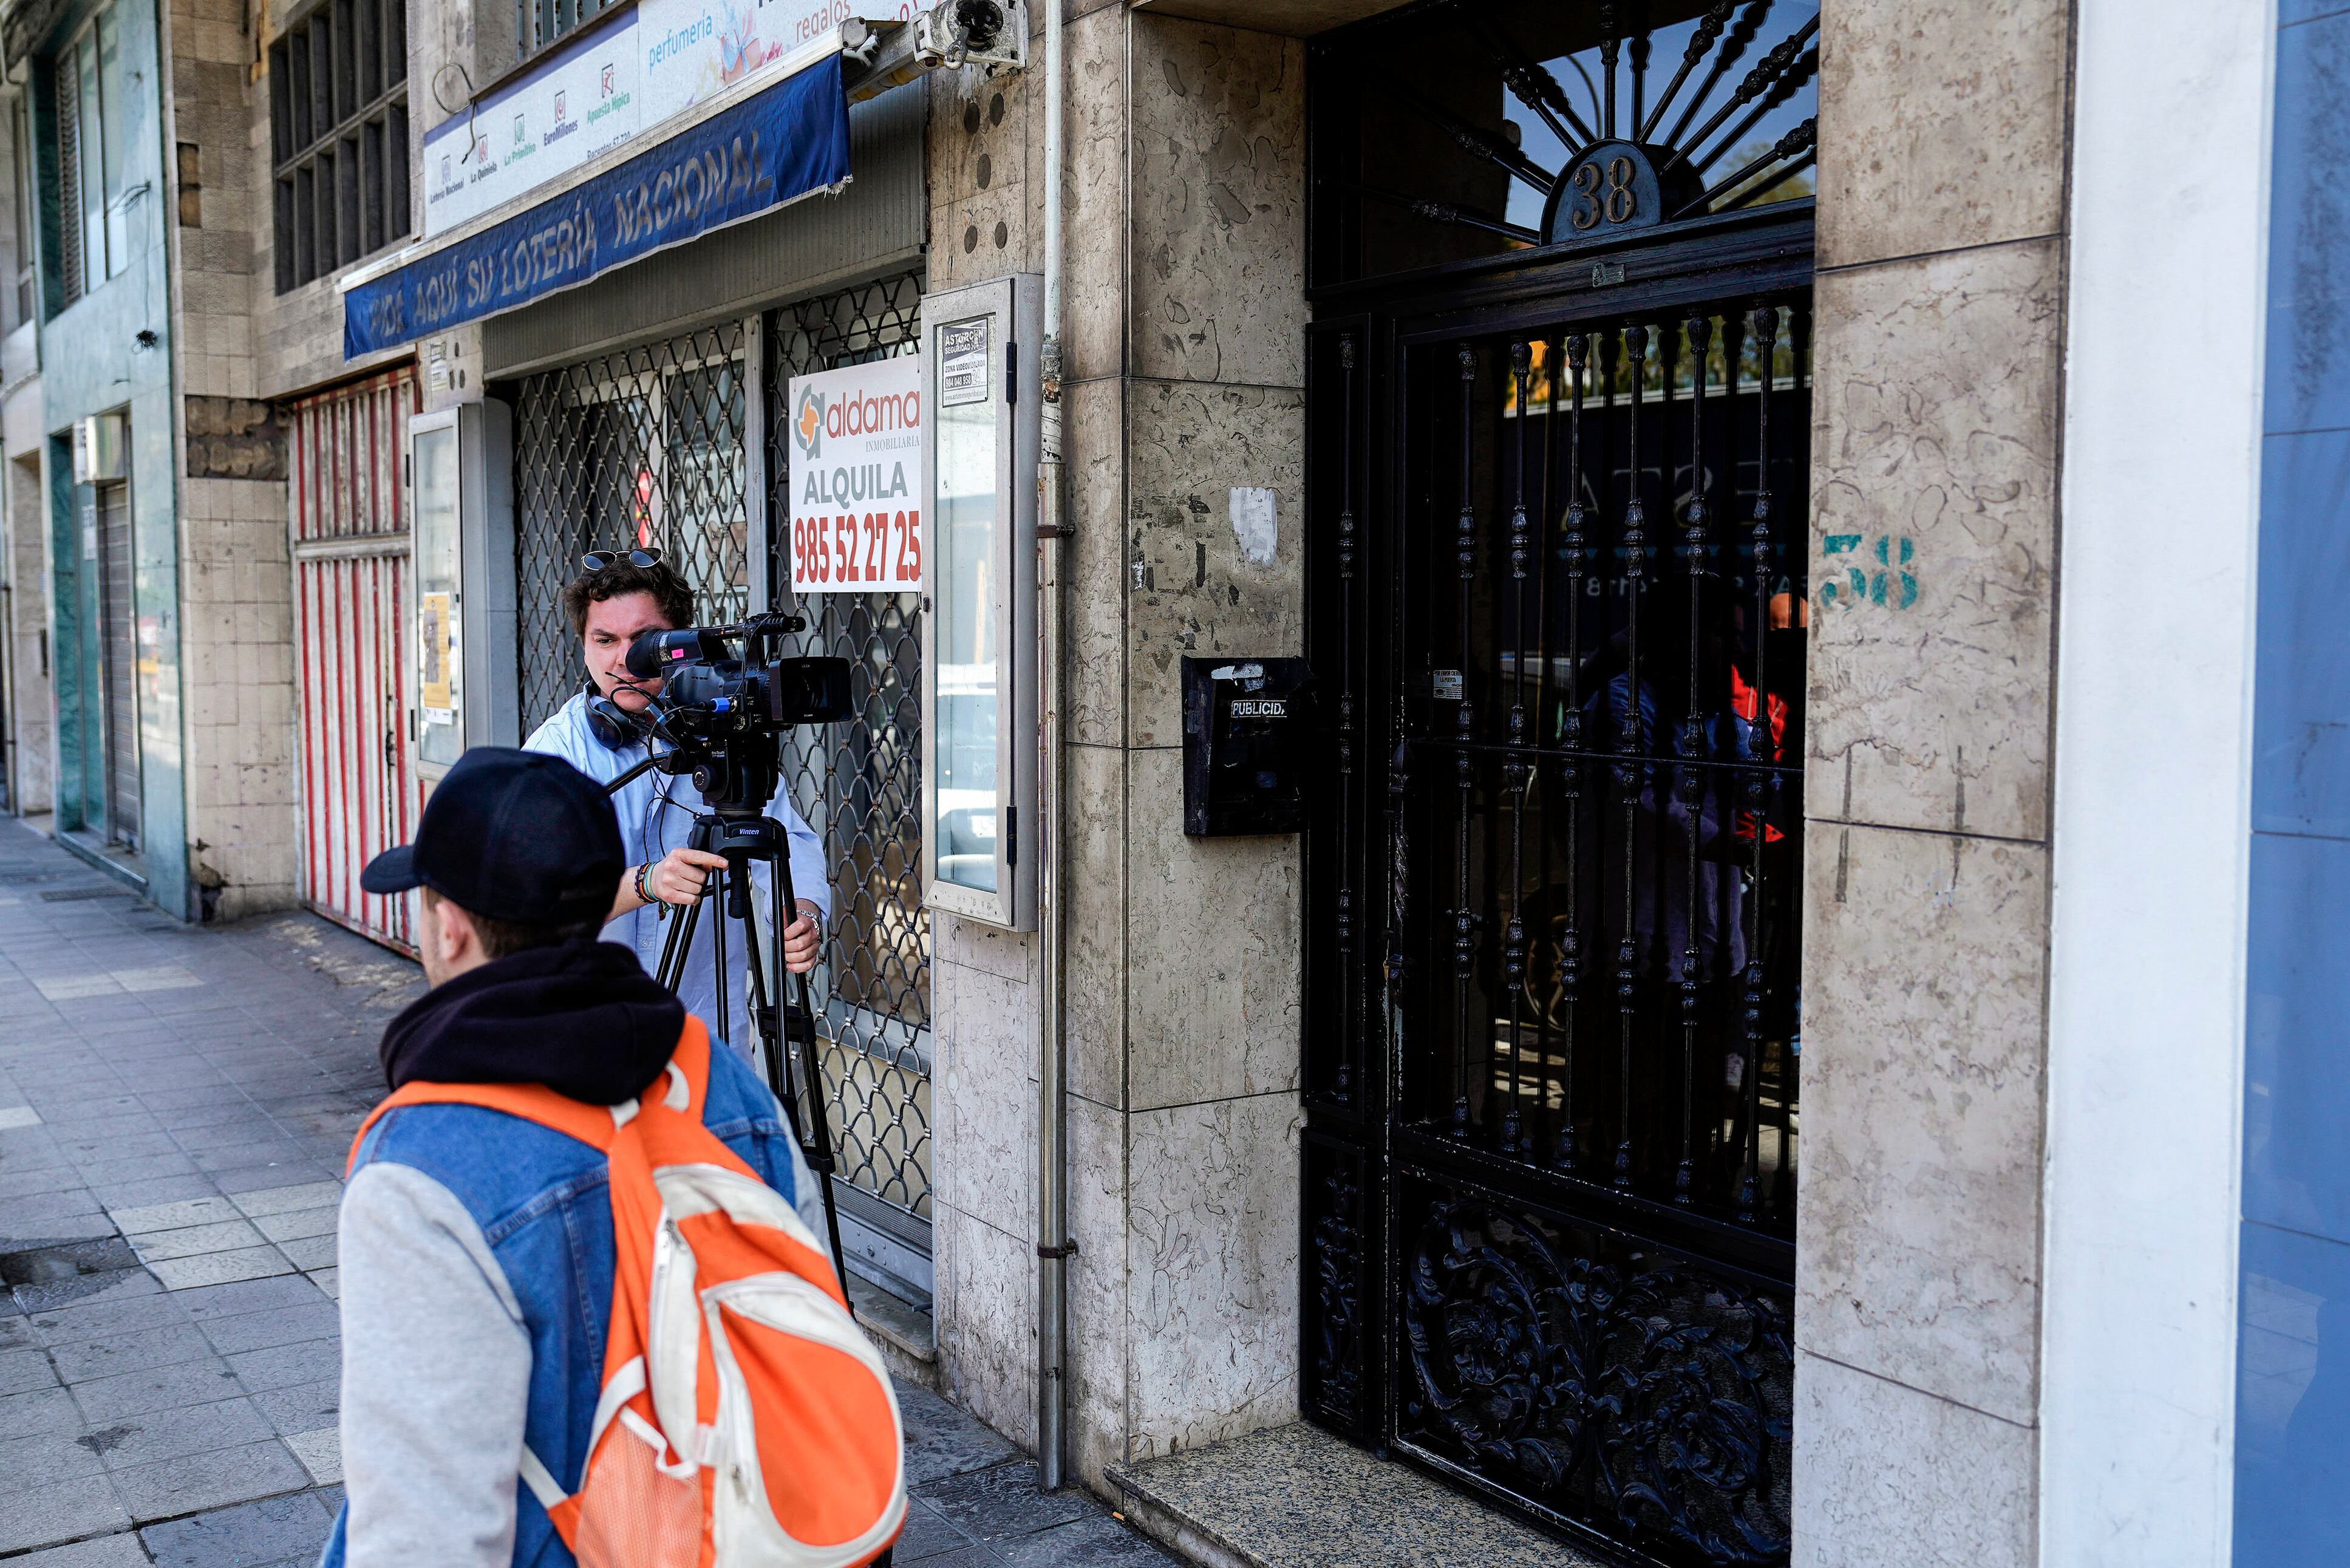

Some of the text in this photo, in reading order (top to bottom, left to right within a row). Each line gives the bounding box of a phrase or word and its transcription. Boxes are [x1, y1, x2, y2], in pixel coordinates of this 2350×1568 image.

[796, 0, 851, 43] regalos
[649, 9, 712, 75] perfumería
[587, 103, 611, 126] Apuesta
[544, 120, 579, 146] EuroMillones
[505, 143, 537, 166] La Primitiva
[471, 162, 498, 184] La Quiniela
[1573, 156, 1635, 230] 38
[414, 254, 458, 327] AQUÍ
[467, 254, 493, 308] SU
[501, 199, 598, 297] LOTERÍA
[613, 130, 774, 249] NACIONAL
[945, 343, 971, 355] SEGURIDAD
[945, 364, 956, 373] ZONA
[945, 377, 954, 388] 984
[962, 374, 972, 385] 958
[826, 389, 920, 438] aldama
[866, 435, 920, 452] INMOBILIARIA
[803, 462, 908, 510] ALQUILA
[795, 511, 921, 583] 985 52 27 25
